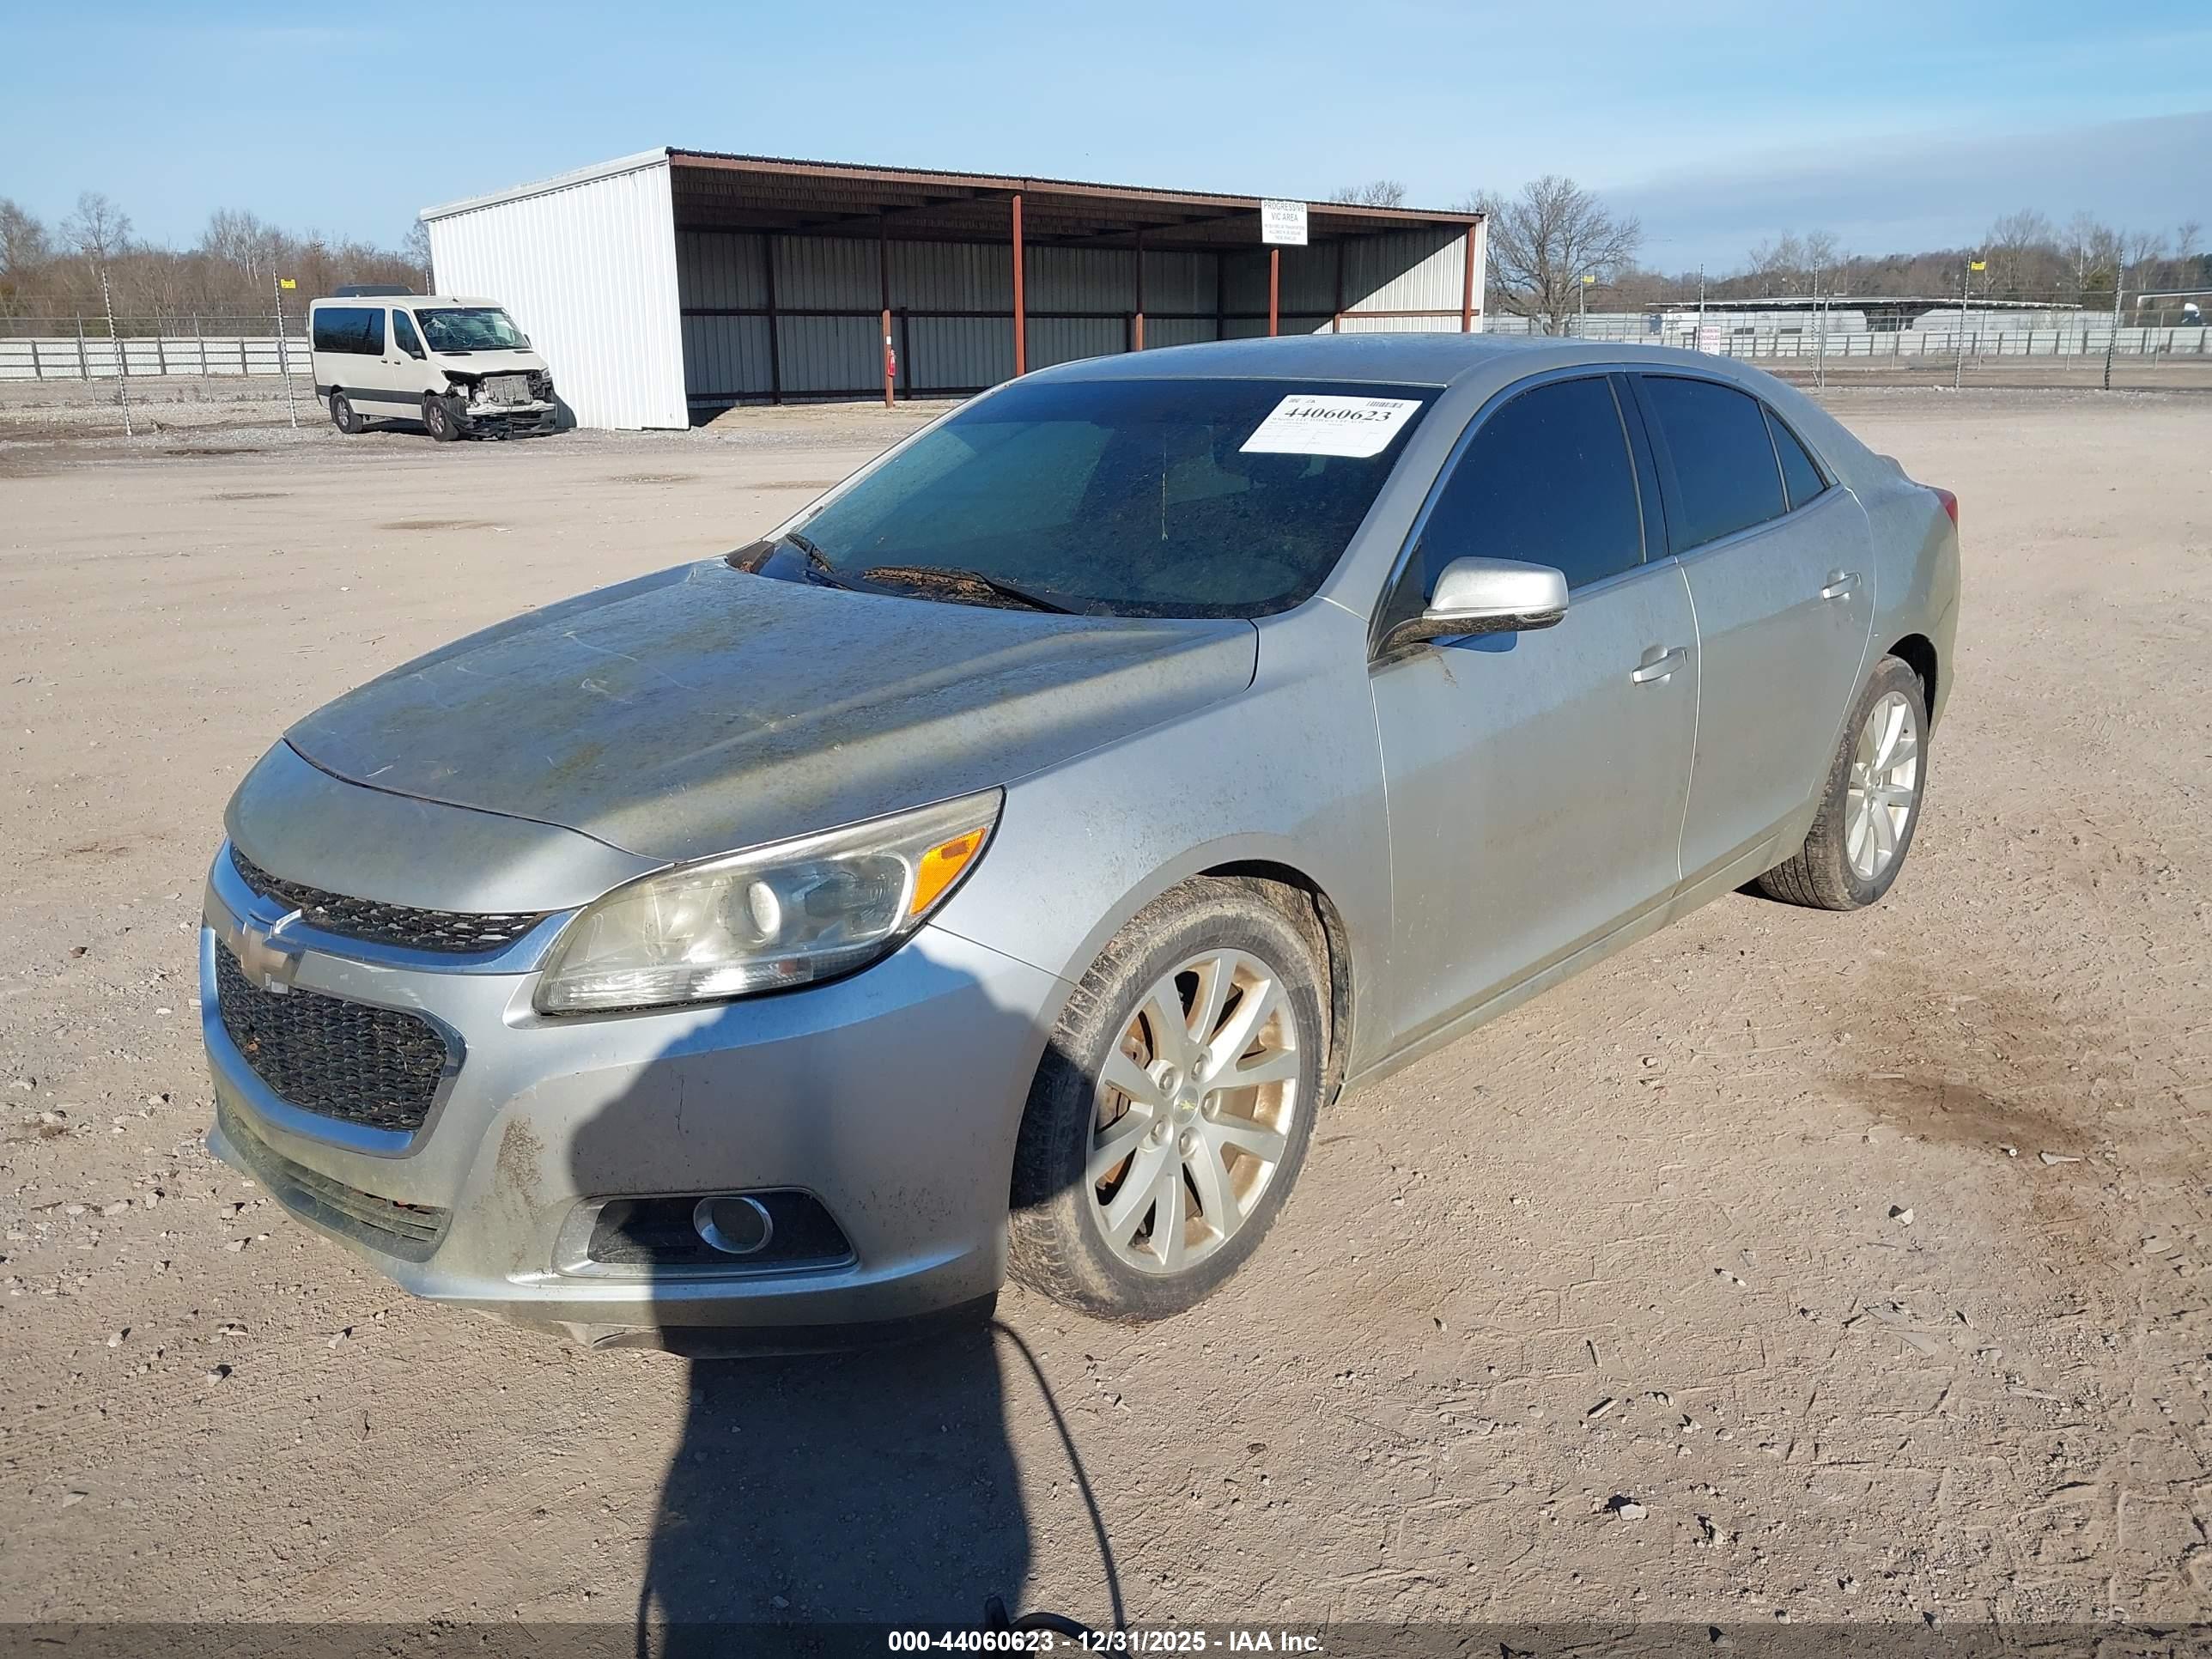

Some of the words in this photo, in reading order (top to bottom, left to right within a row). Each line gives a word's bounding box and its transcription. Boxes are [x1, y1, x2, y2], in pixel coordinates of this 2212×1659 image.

[1263, 201, 1305, 212] PROGRESSIVE
[1282, 213, 1299, 222] AREA
[1284, 406, 1392, 422] 44060623
